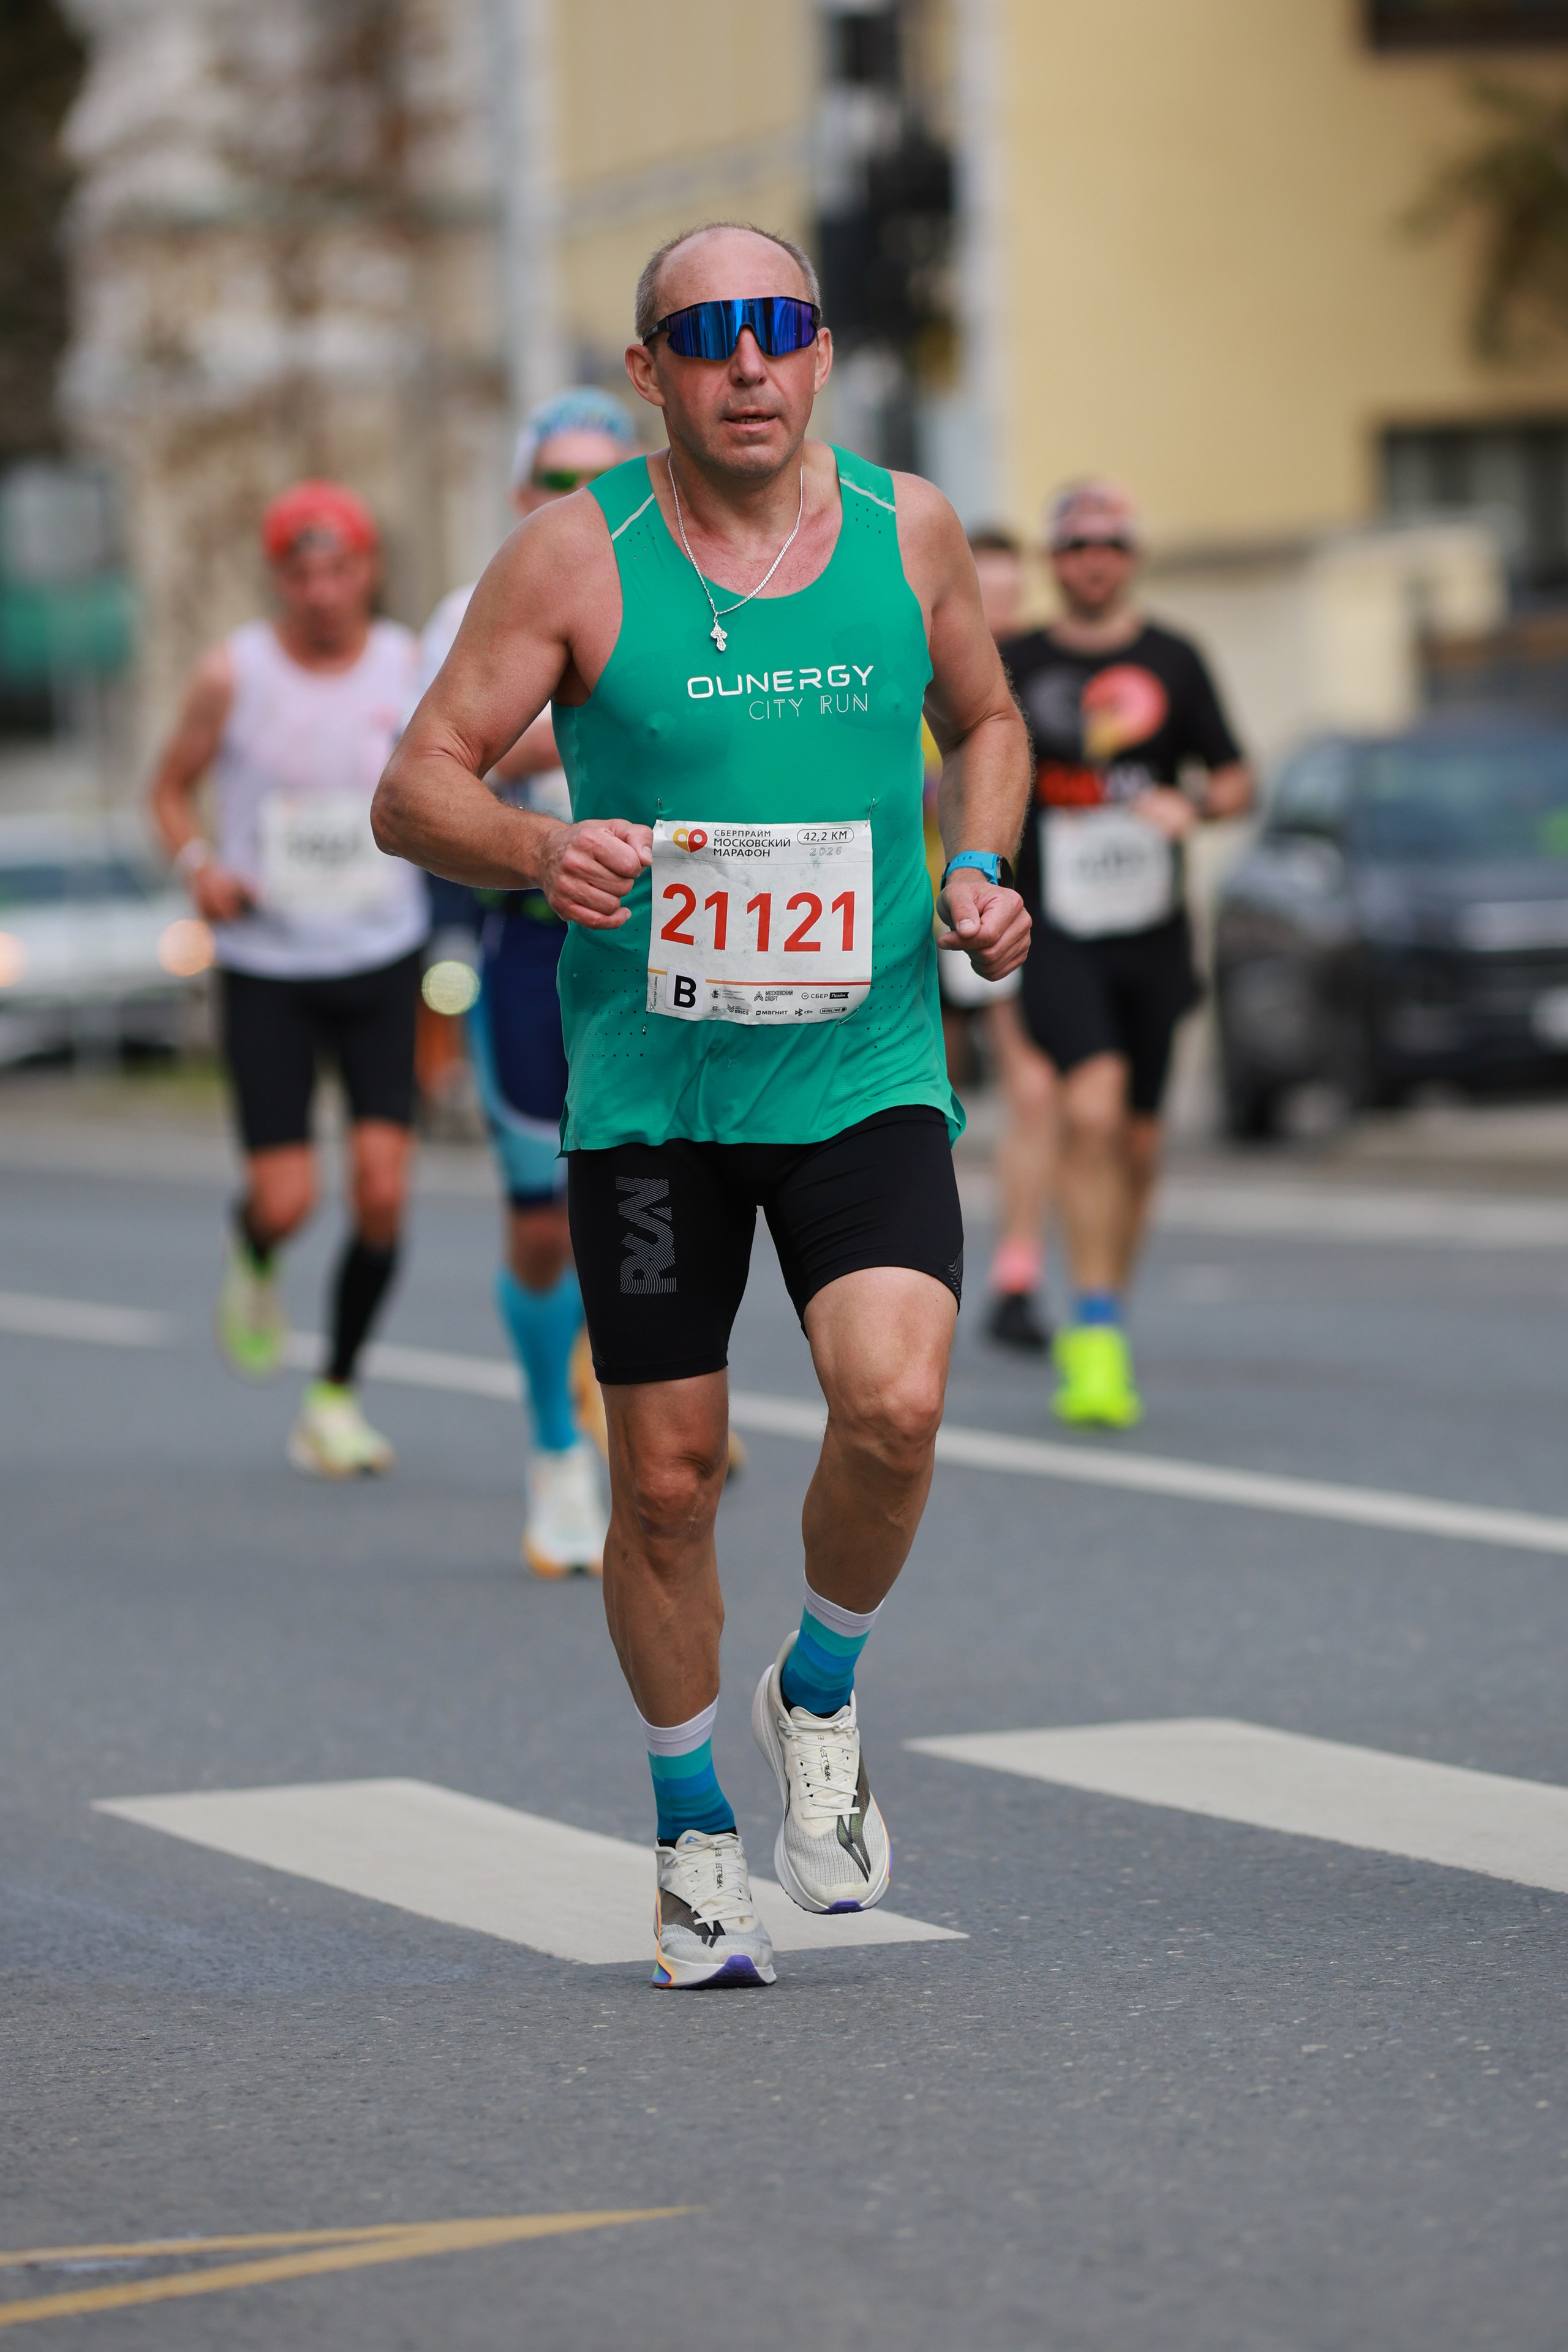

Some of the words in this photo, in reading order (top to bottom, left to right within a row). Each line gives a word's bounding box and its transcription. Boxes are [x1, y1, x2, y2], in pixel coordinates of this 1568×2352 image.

[748, 697, 804, 720] CITY
[820, 693, 868, 715] RUN
[714, 829, 771, 837] СБЕРПРАЙМ
[803, 832, 827, 842] 42,2
[714, 837, 791, 848] МОСКОВСКИЙ
[713, 848, 771, 858] МАРАФОН
[660, 883, 856, 952] 21121
[615, 1175, 678, 1295] RUN
